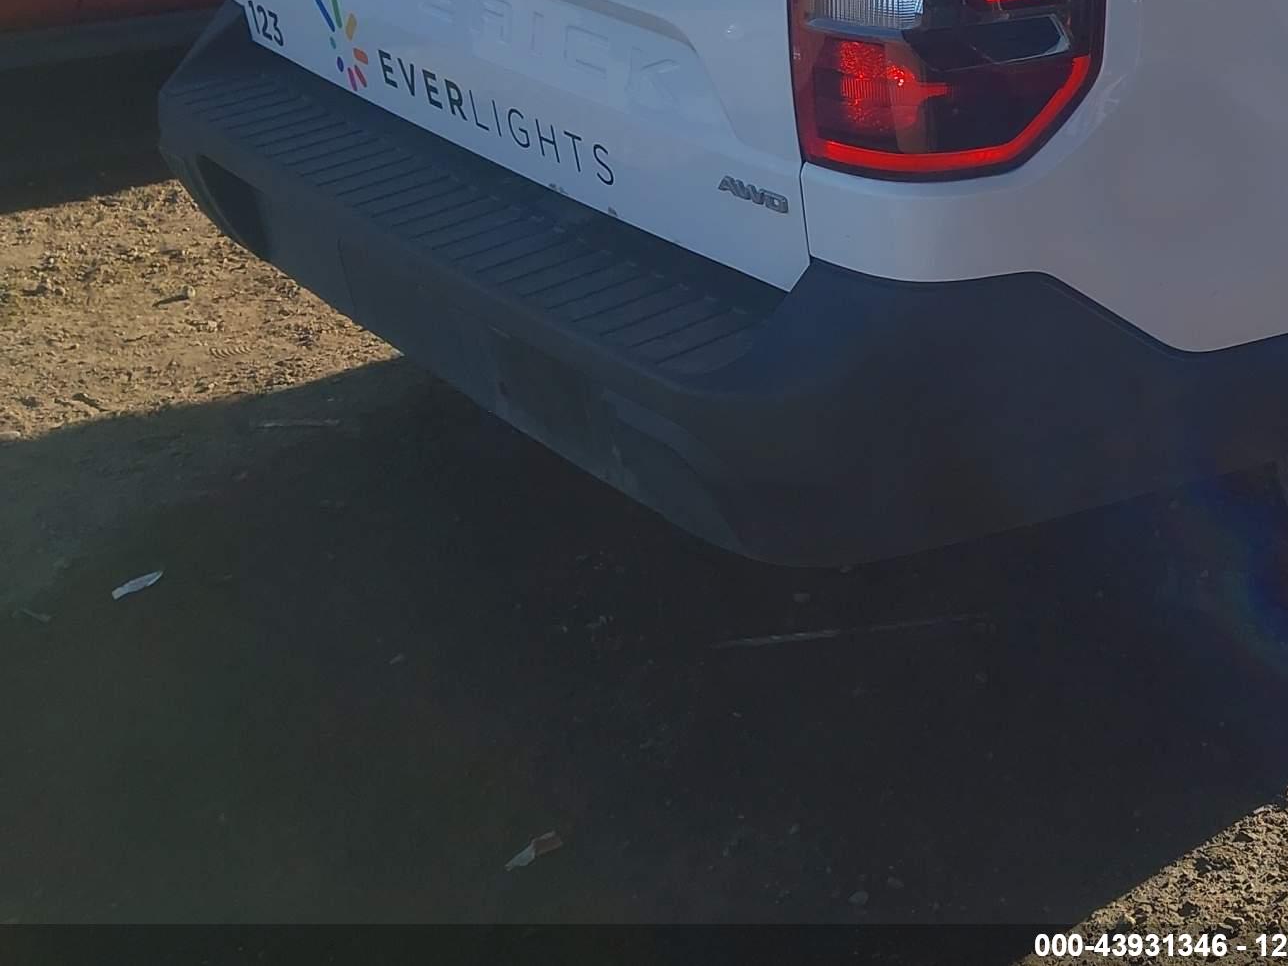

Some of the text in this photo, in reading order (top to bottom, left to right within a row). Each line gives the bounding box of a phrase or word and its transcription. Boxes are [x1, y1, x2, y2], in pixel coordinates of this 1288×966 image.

[247, 0, 284, 47] 123
[377, 48, 615, 186] EVERLIGHTS
[718, 175, 789, 214] AWD
